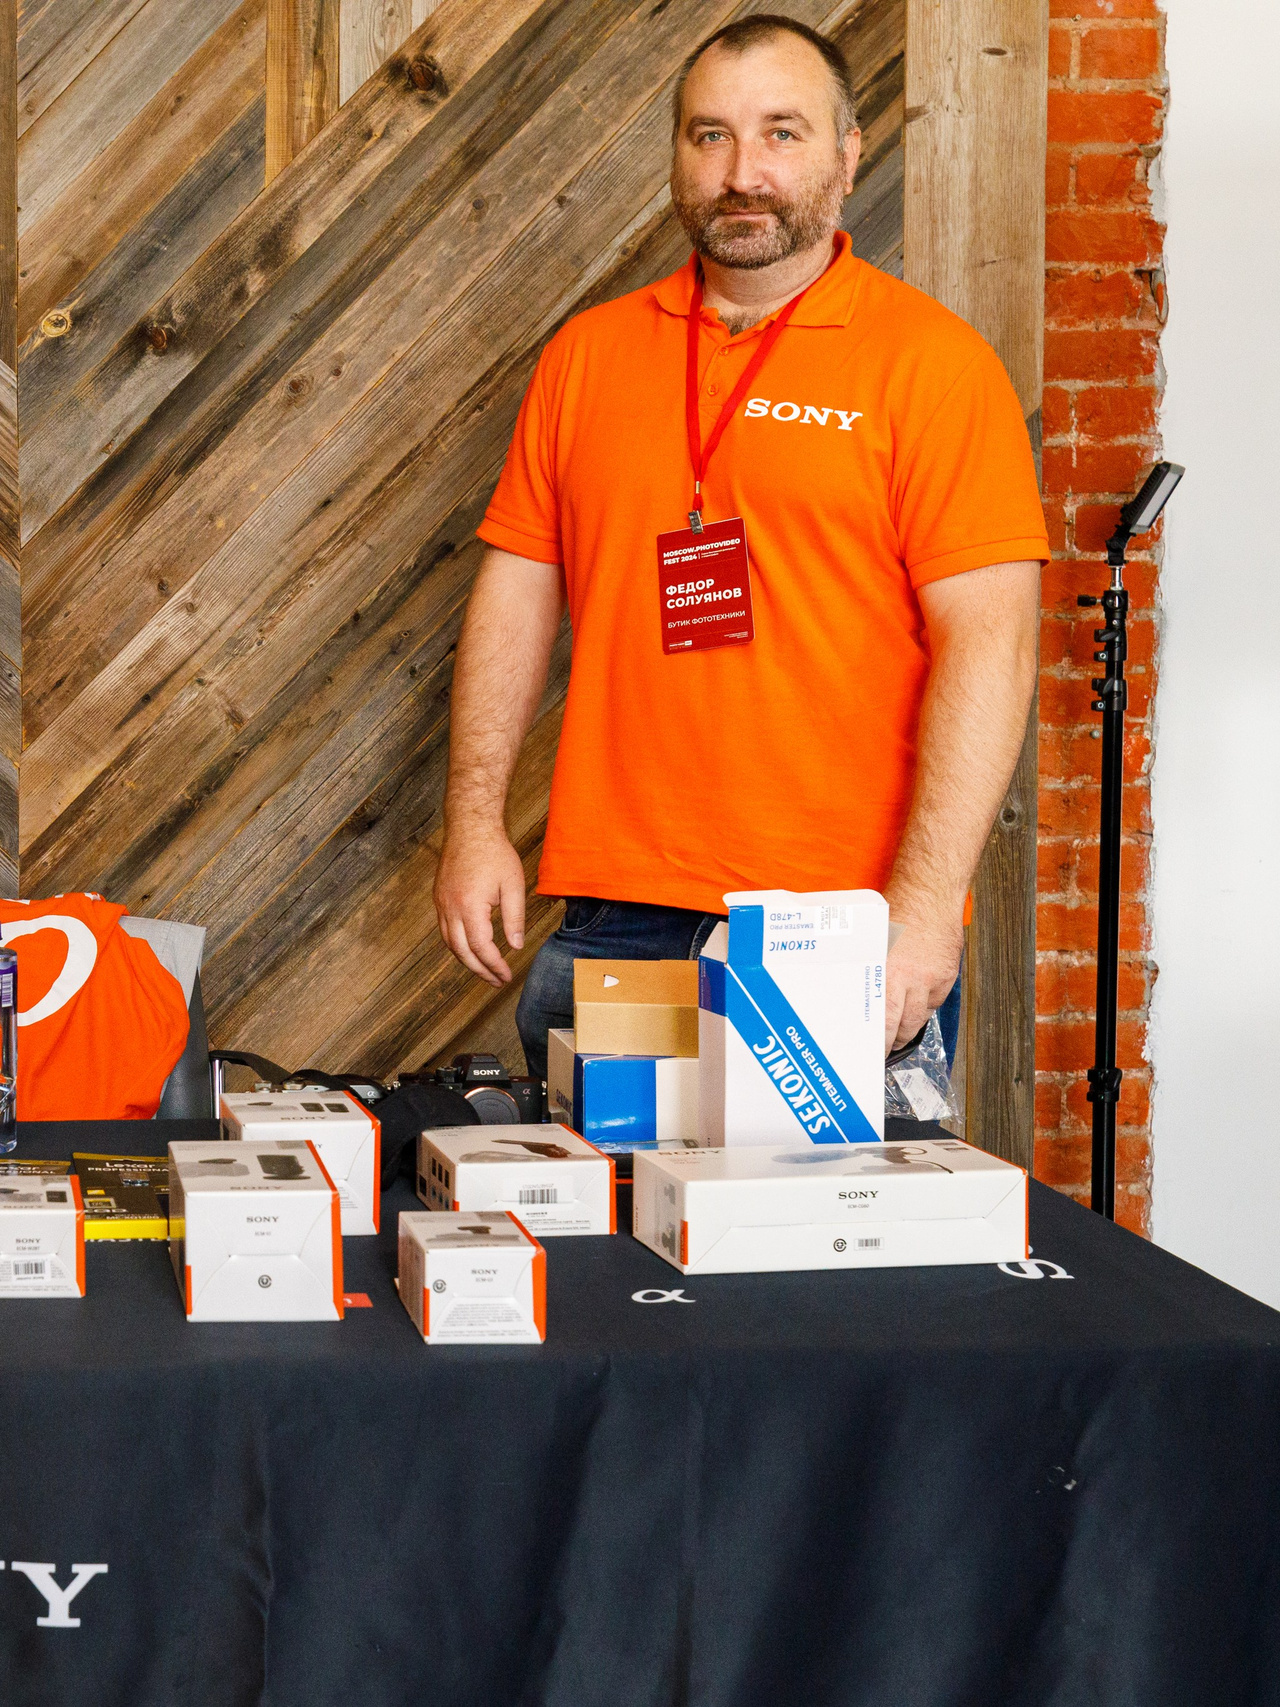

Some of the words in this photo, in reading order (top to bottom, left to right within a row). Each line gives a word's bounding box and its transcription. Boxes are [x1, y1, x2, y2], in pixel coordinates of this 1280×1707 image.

[744, 397, 863, 431] SONY
[663, 538, 741, 558] MOSCOW.PHOTOVIDEO
[663, 556, 680, 566] FEST
[665, 578, 715, 596] ФЕДОР
[666, 587, 742, 609] СОЛУЯНОВ
[667, 619, 691, 629] БУТИК
[691, 610, 746, 625] ФОТОТЕХНИКИ
[769, 939, 817, 952] SEKONIC
[874, 965, 883, 998] L-478D
[785, 1026, 806, 1050] PRO
[753, 1035, 831, 1134] SEKONIC
[801, 1047, 848, 1112] LITEMASTER
[838, 1190, 879, 1200] SONY
[246, 1215, 280, 1223] SONY
